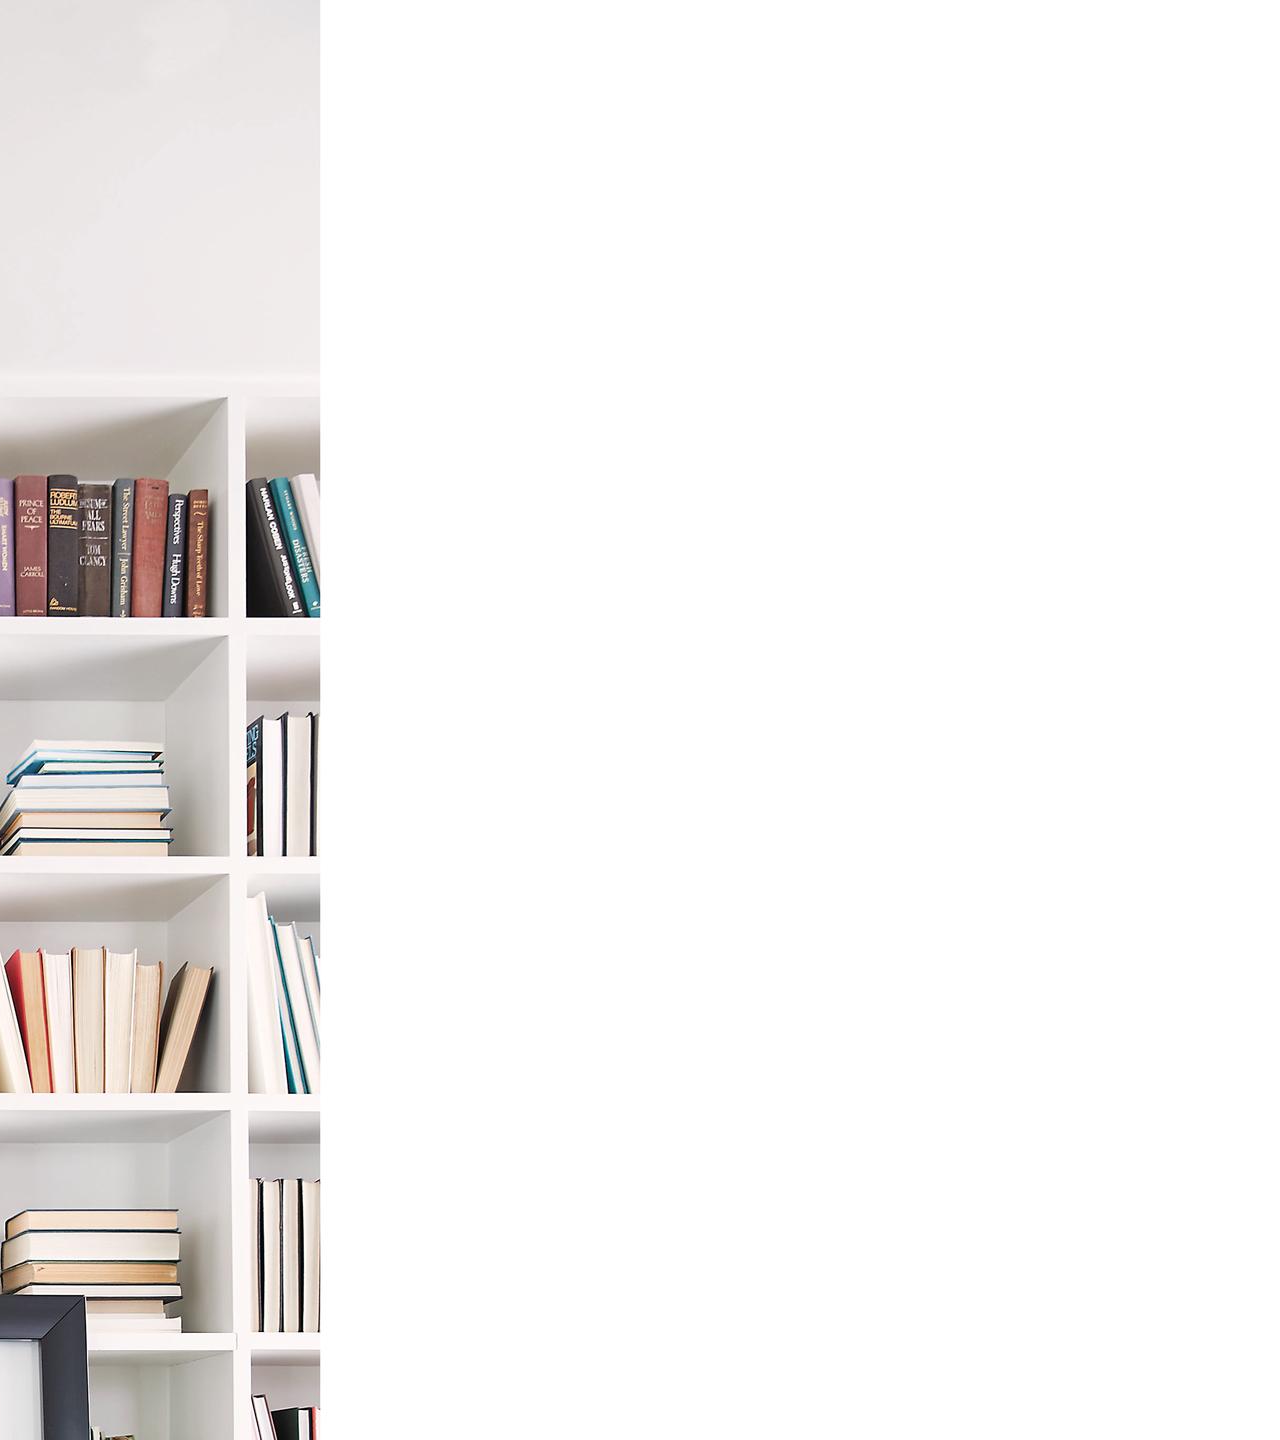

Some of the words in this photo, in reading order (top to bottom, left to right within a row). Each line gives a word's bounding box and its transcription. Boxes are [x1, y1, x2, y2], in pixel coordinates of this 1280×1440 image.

[50, 492, 77, 500] ROBERT
[123, 487, 131, 501] The
[19, 500, 44, 508] PRINCE
[50, 499, 78, 507] LUDLUM
[86, 499, 100, 509] SUM
[87, 510, 101, 520] ALL
[122, 502, 130, 523] Street
[260, 487, 274, 521] HARLAN
[270, 521, 282, 550] COBEN
[82, 521, 105, 531] FEARS
[172, 500, 184, 545] Perspectives
[86, 544, 100, 555] TOM
[195, 531, 203, 552] Sharp
[80, 556, 106, 566] CLANCY
[120, 558, 128, 574] John
[170, 554, 181, 577] Hugh
[293, 539, 310, 583] DISASTERS
[302, 546, 312, 572] FRESH
[120, 576, 129, 606] Grisham
[170, 577, 180, 604] Downs
